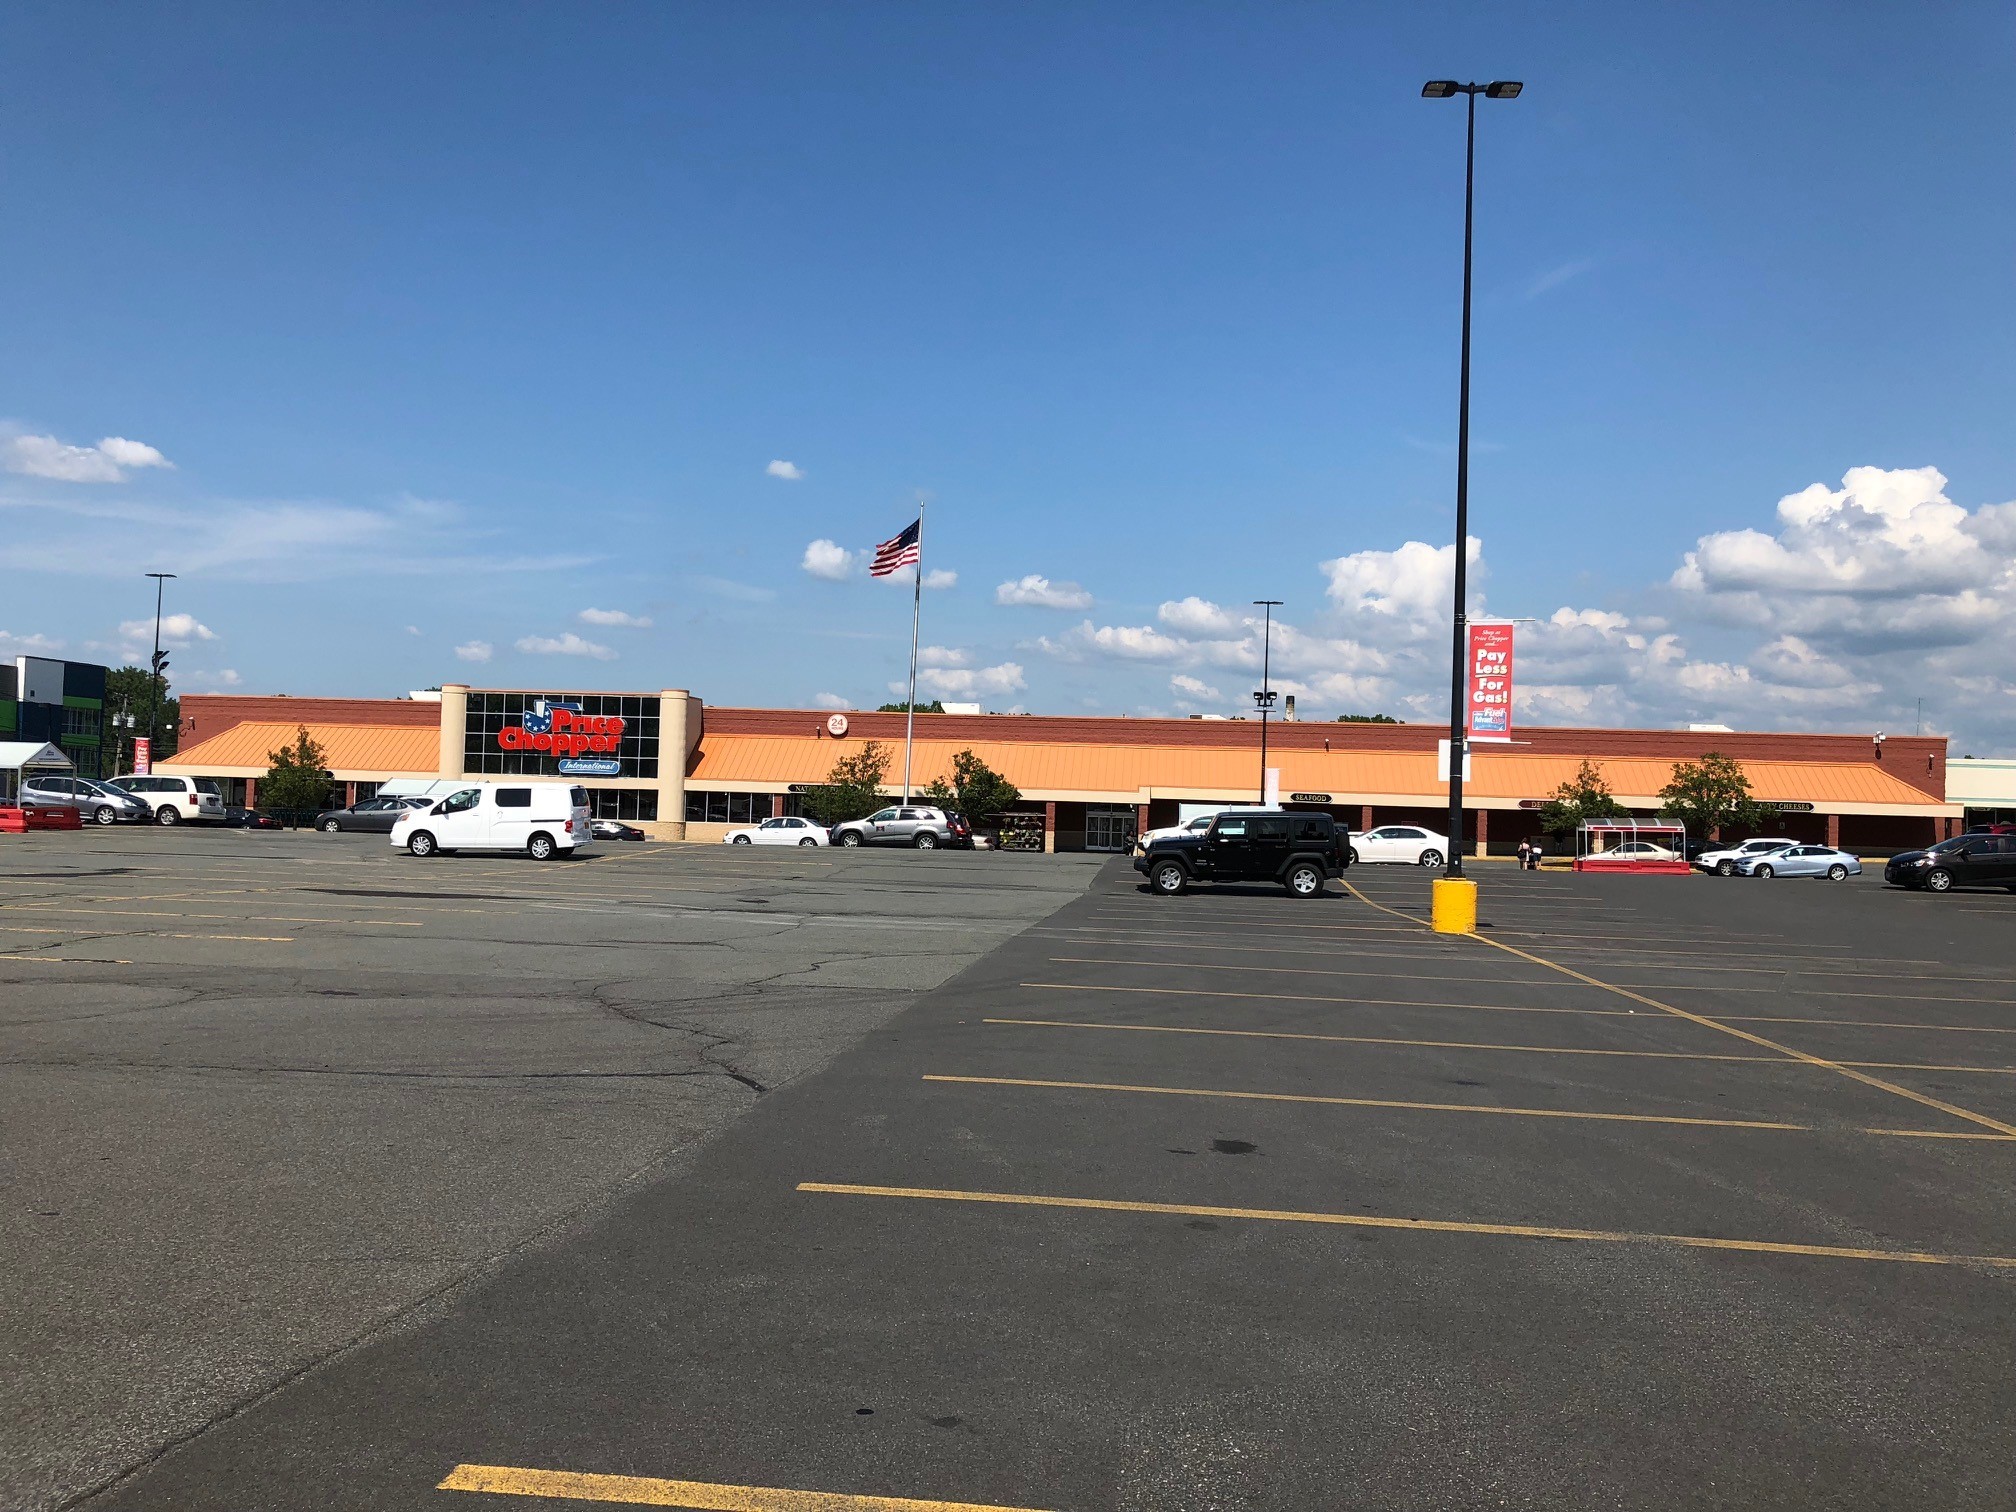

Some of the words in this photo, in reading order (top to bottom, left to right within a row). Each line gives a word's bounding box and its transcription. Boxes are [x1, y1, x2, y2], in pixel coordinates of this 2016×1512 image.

[1477, 648, 1507, 664] Pay
[1475, 661, 1507, 674] Less
[1478, 677, 1503, 690] For
[1472, 690, 1508, 704] Gas!
[1484, 708, 1505, 717] Fuel
[552, 709, 627, 735] Price
[831, 718, 844, 727] 24
[497, 726, 622, 757] Chopper
[564, 761, 615, 770] International
[1295, 794, 1327, 802] SEAFOOD
[1778, 802, 1810, 811] CHEESES
